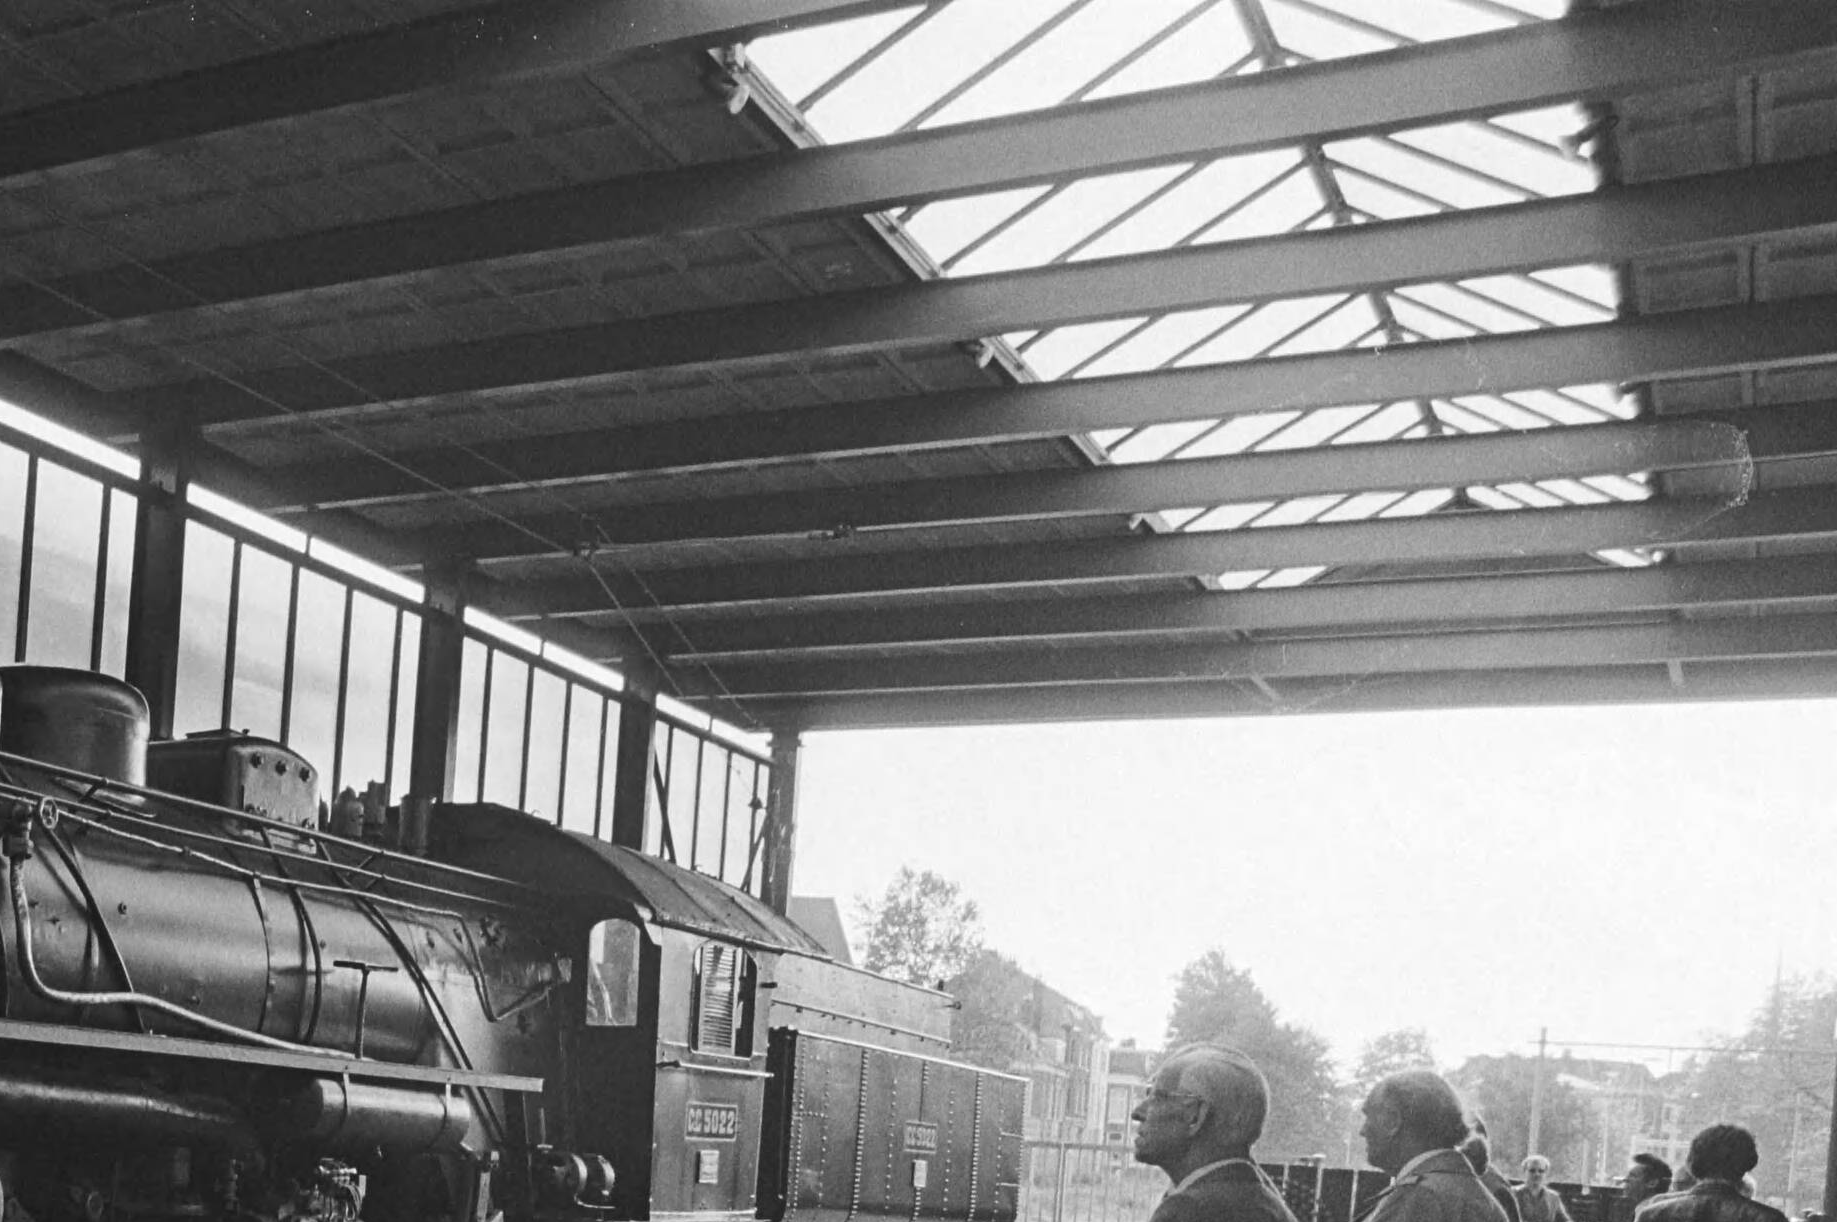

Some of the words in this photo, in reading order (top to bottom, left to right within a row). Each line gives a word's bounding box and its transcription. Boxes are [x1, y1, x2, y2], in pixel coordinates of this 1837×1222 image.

[688, 1108, 702, 1132] CC
[704, 1109, 735, 1134] 5022
[916, 1127, 936, 1148] 5022
